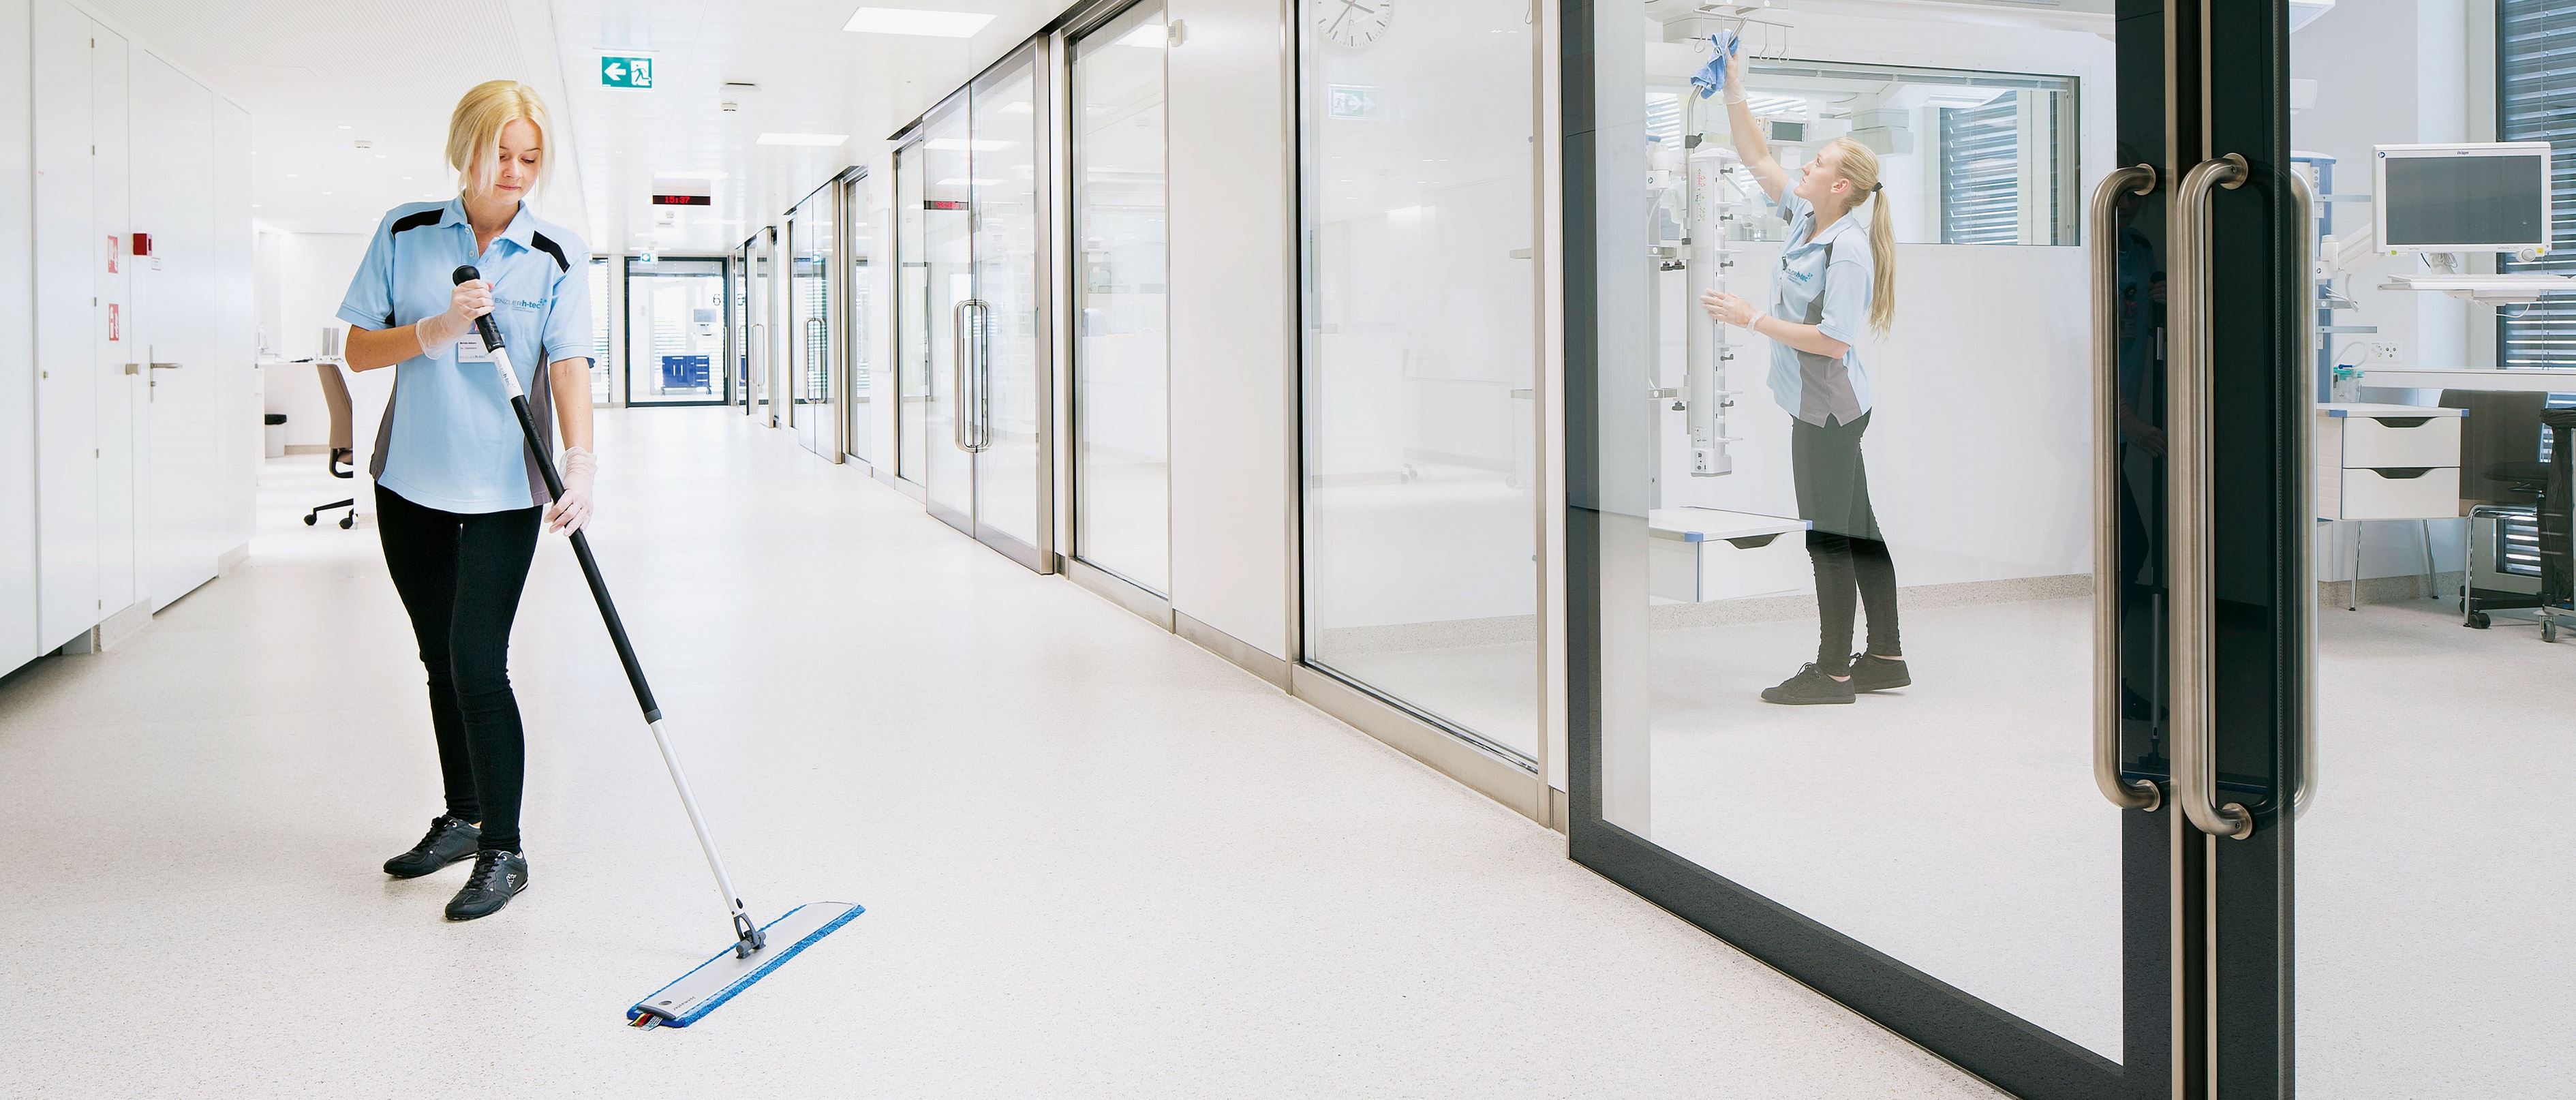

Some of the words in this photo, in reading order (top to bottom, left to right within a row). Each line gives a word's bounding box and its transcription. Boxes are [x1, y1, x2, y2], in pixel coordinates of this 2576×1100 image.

[664, 196, 690, 204] 15:37
[494, 297, 541, 309] ENZLERh-tec
[713, 293, 721, 306] 6
